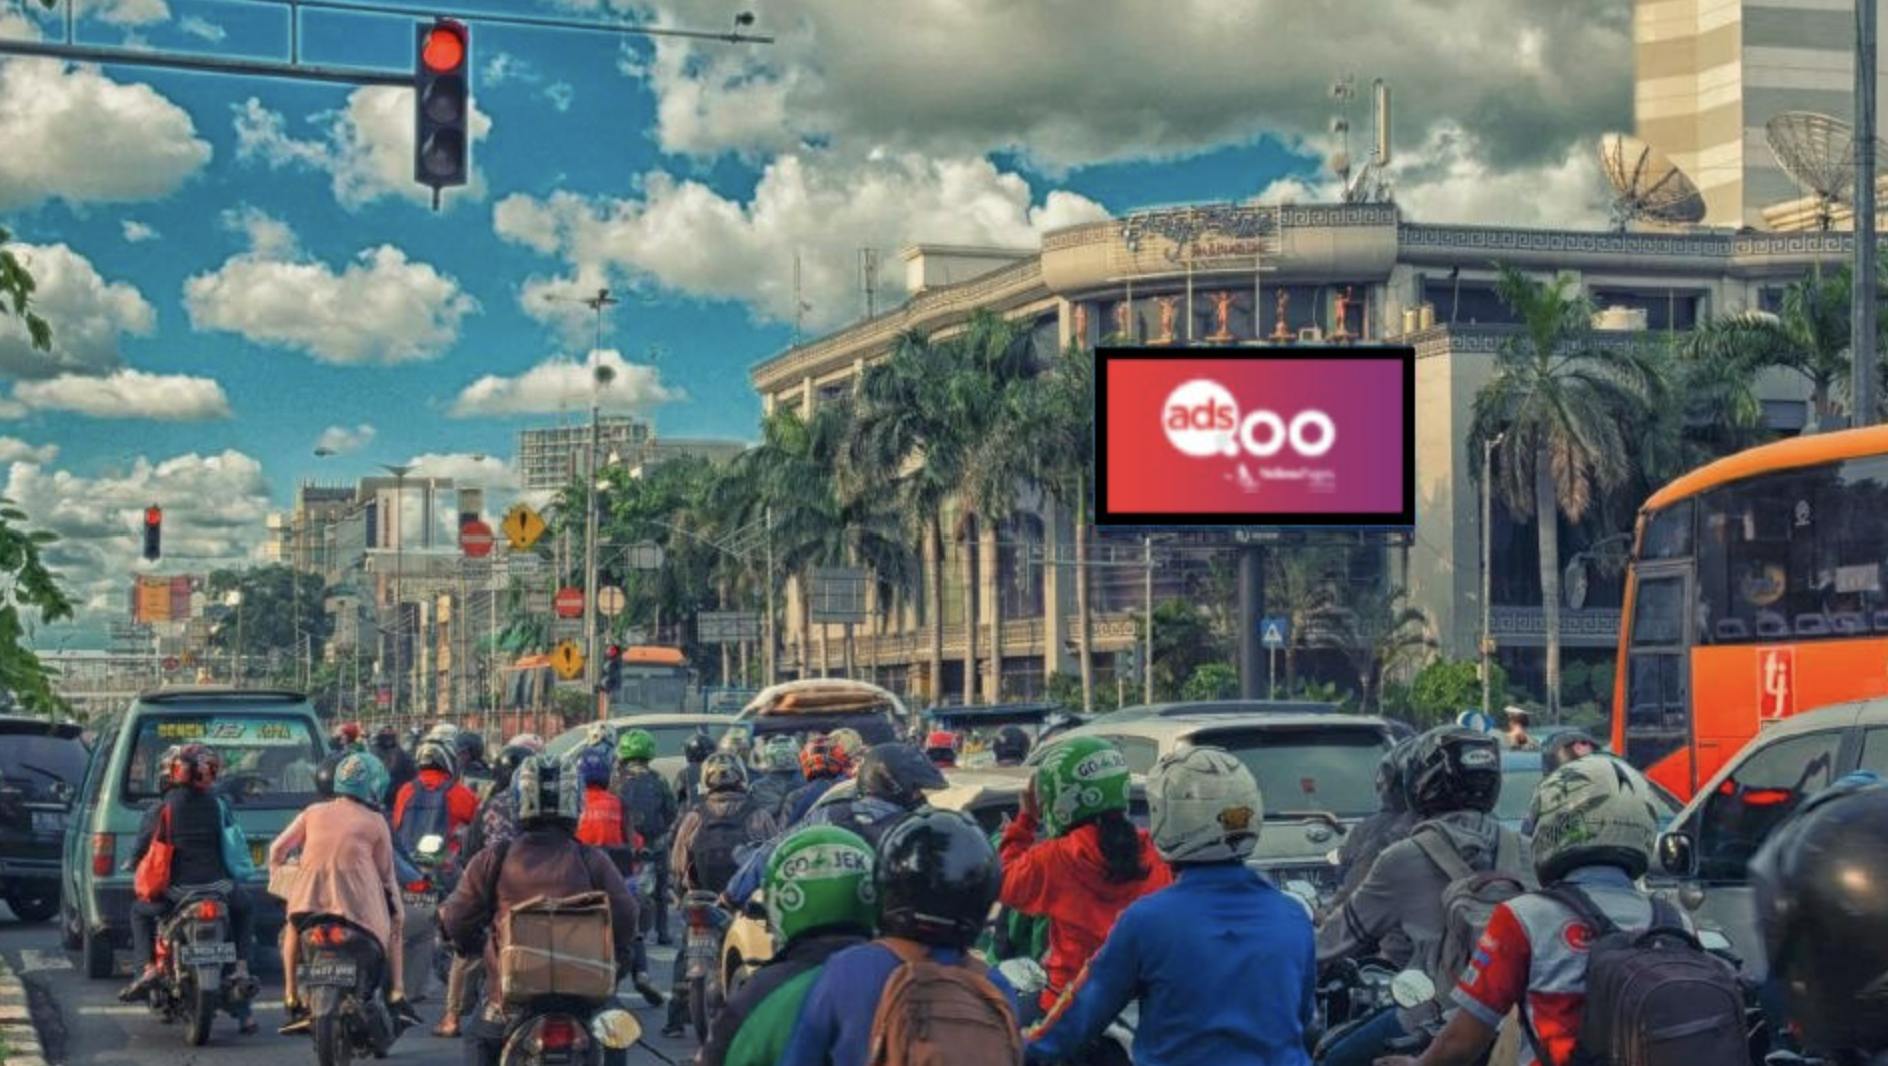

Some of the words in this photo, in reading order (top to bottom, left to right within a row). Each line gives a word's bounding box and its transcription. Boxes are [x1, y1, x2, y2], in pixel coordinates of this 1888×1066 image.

[1168, 397, 1234, 431] ads
[1765, 651, 1788, 719] tj
[1078, 760, 1098, 777] GO
[784, 857, 809, 879] GO
[834, 851, 866, 870] JEK
